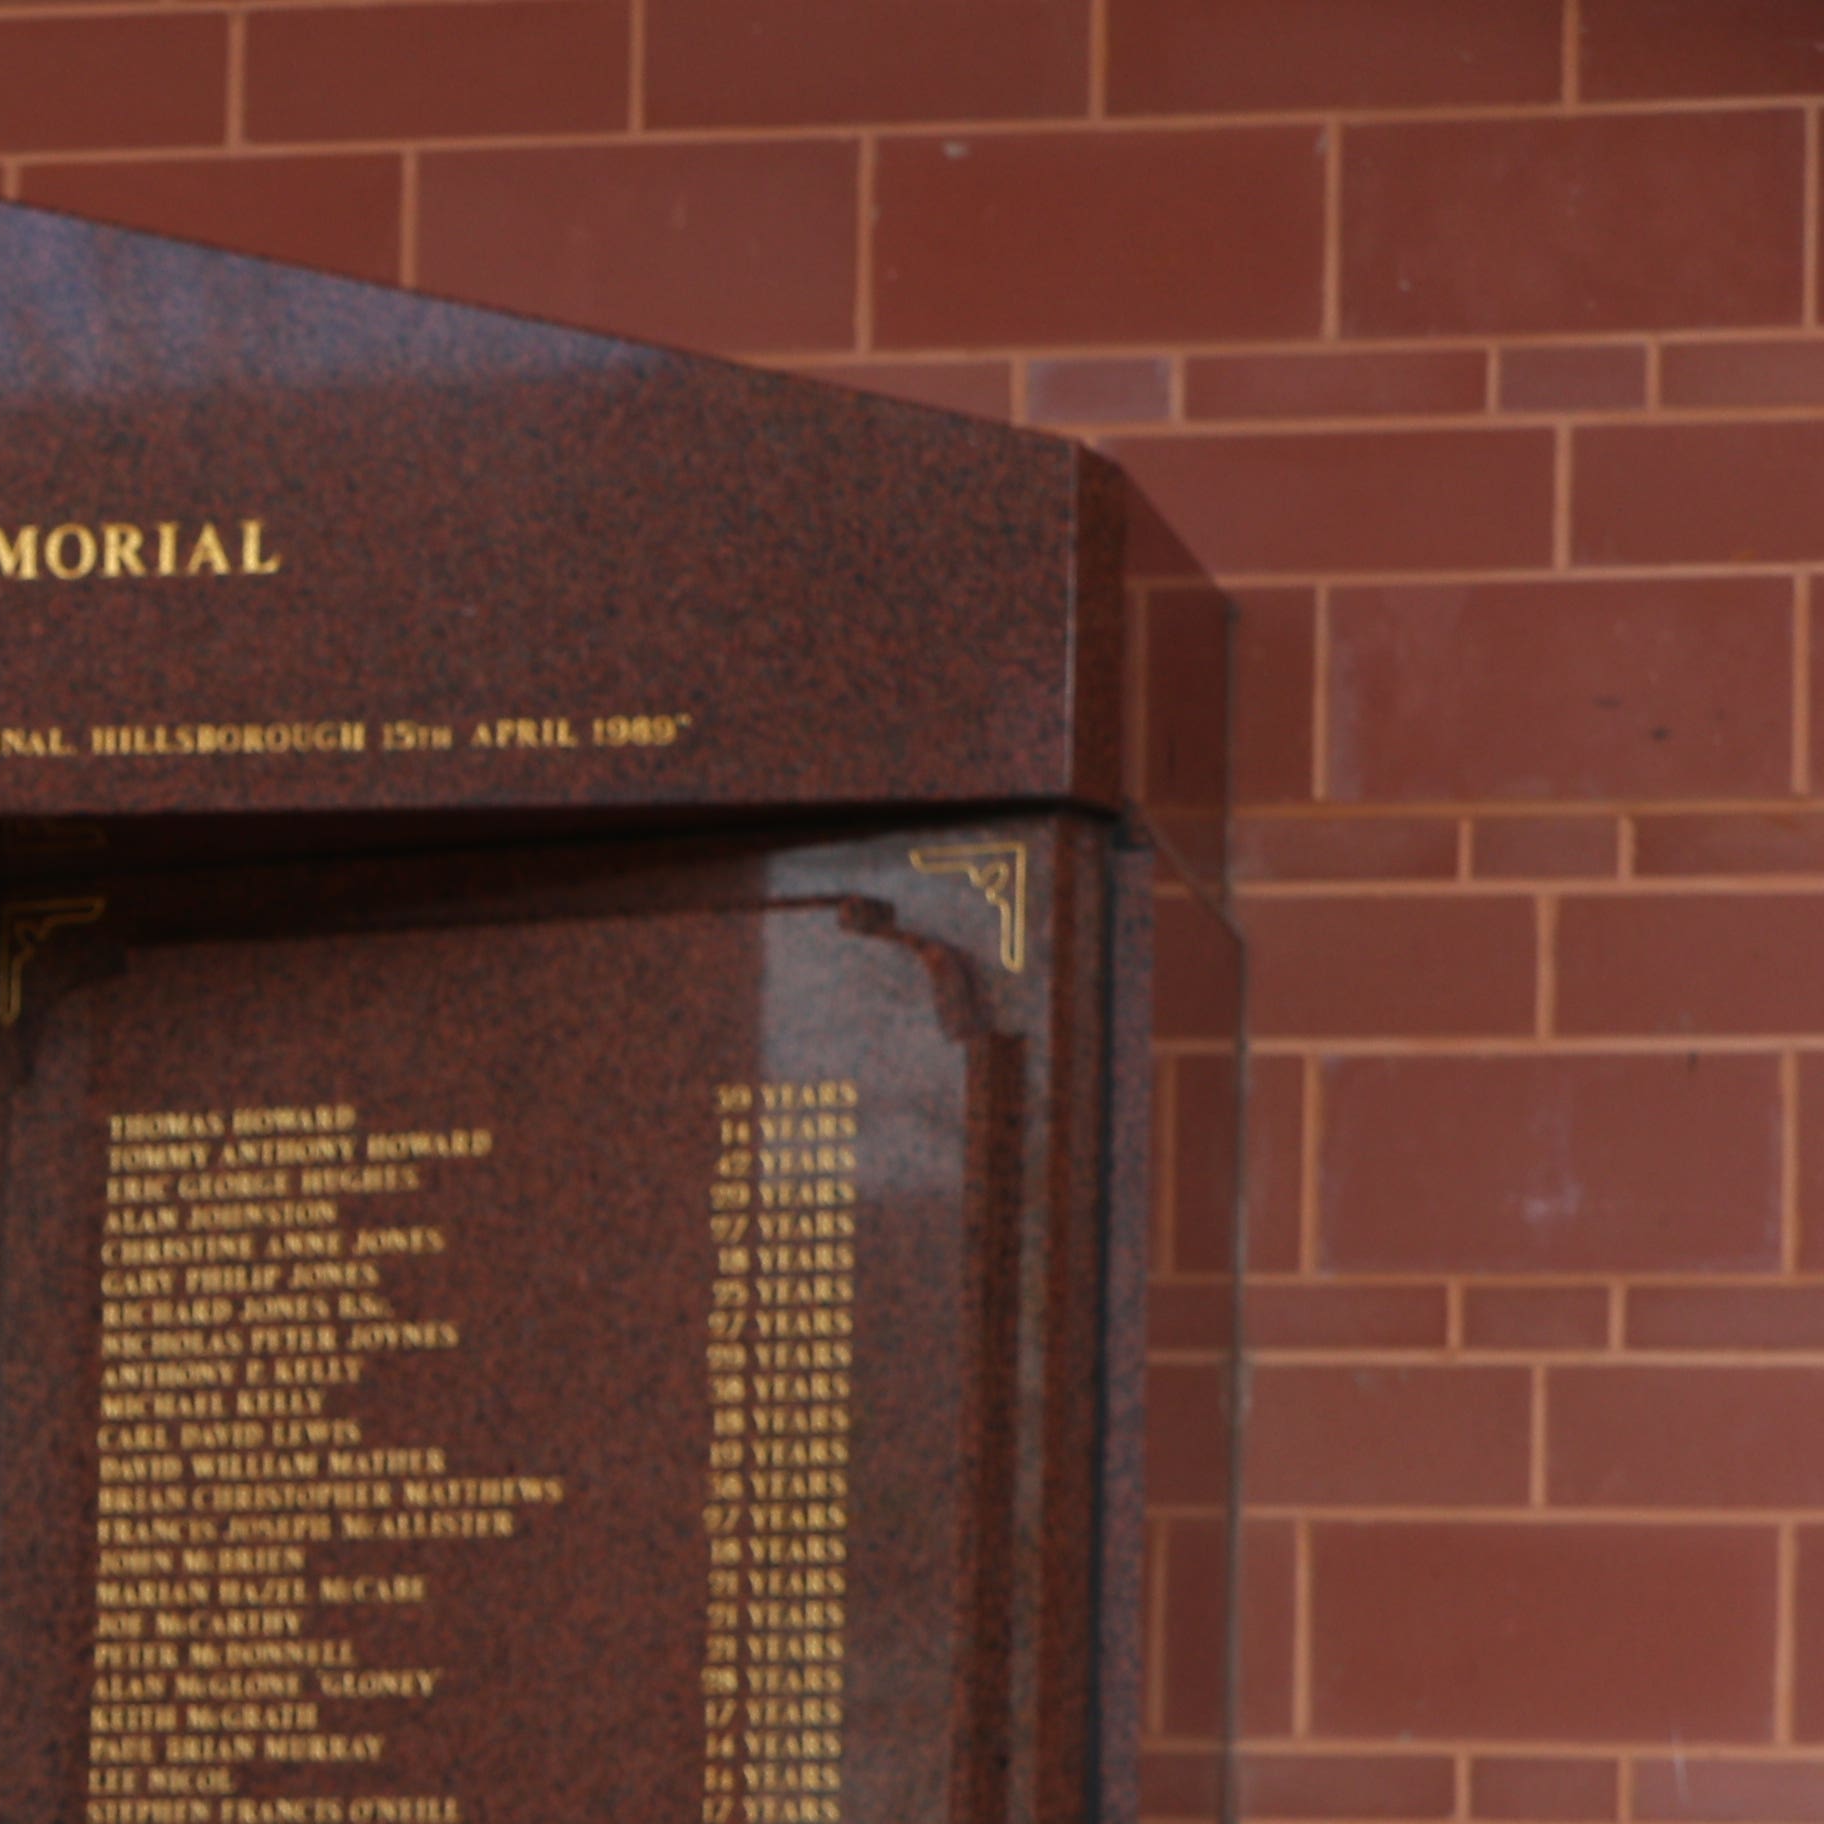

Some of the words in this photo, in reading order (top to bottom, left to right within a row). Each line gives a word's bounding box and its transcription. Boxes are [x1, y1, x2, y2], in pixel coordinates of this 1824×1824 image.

[88, 720, 369, 757] HILLSBOROUGH
[471, 716, 580, 750] APRIL
[105, 1110, 228, 1143] THOMAS
[229, 1102, 360, 1136] HOWARD
[105, 1141, 212, 1174] TOMMY
[219, 1135, 358, 1168] ANTHONY
[363, 1127, 496, 1162] HOWARD
[755, 1210, 859, 1241] YEARS
[97, 1233, 257, 1267] CHRISTINE
[264, 1229, 345, 1259] ANNE
[351, 1225, 449, 1257] JONES
[754, 1242, 858, 1274] YEARS
[97, 1268, 177, 1298] GARY
[182, 1262, 284, 1295] PHILIP
[287, 1260, 383, 1290] JONES
[96, 1453, 186, 1484] DAVID
[188, 1451, 321, 1481] WILLIAM
[326, 1445, 449, 1476] MATHER
